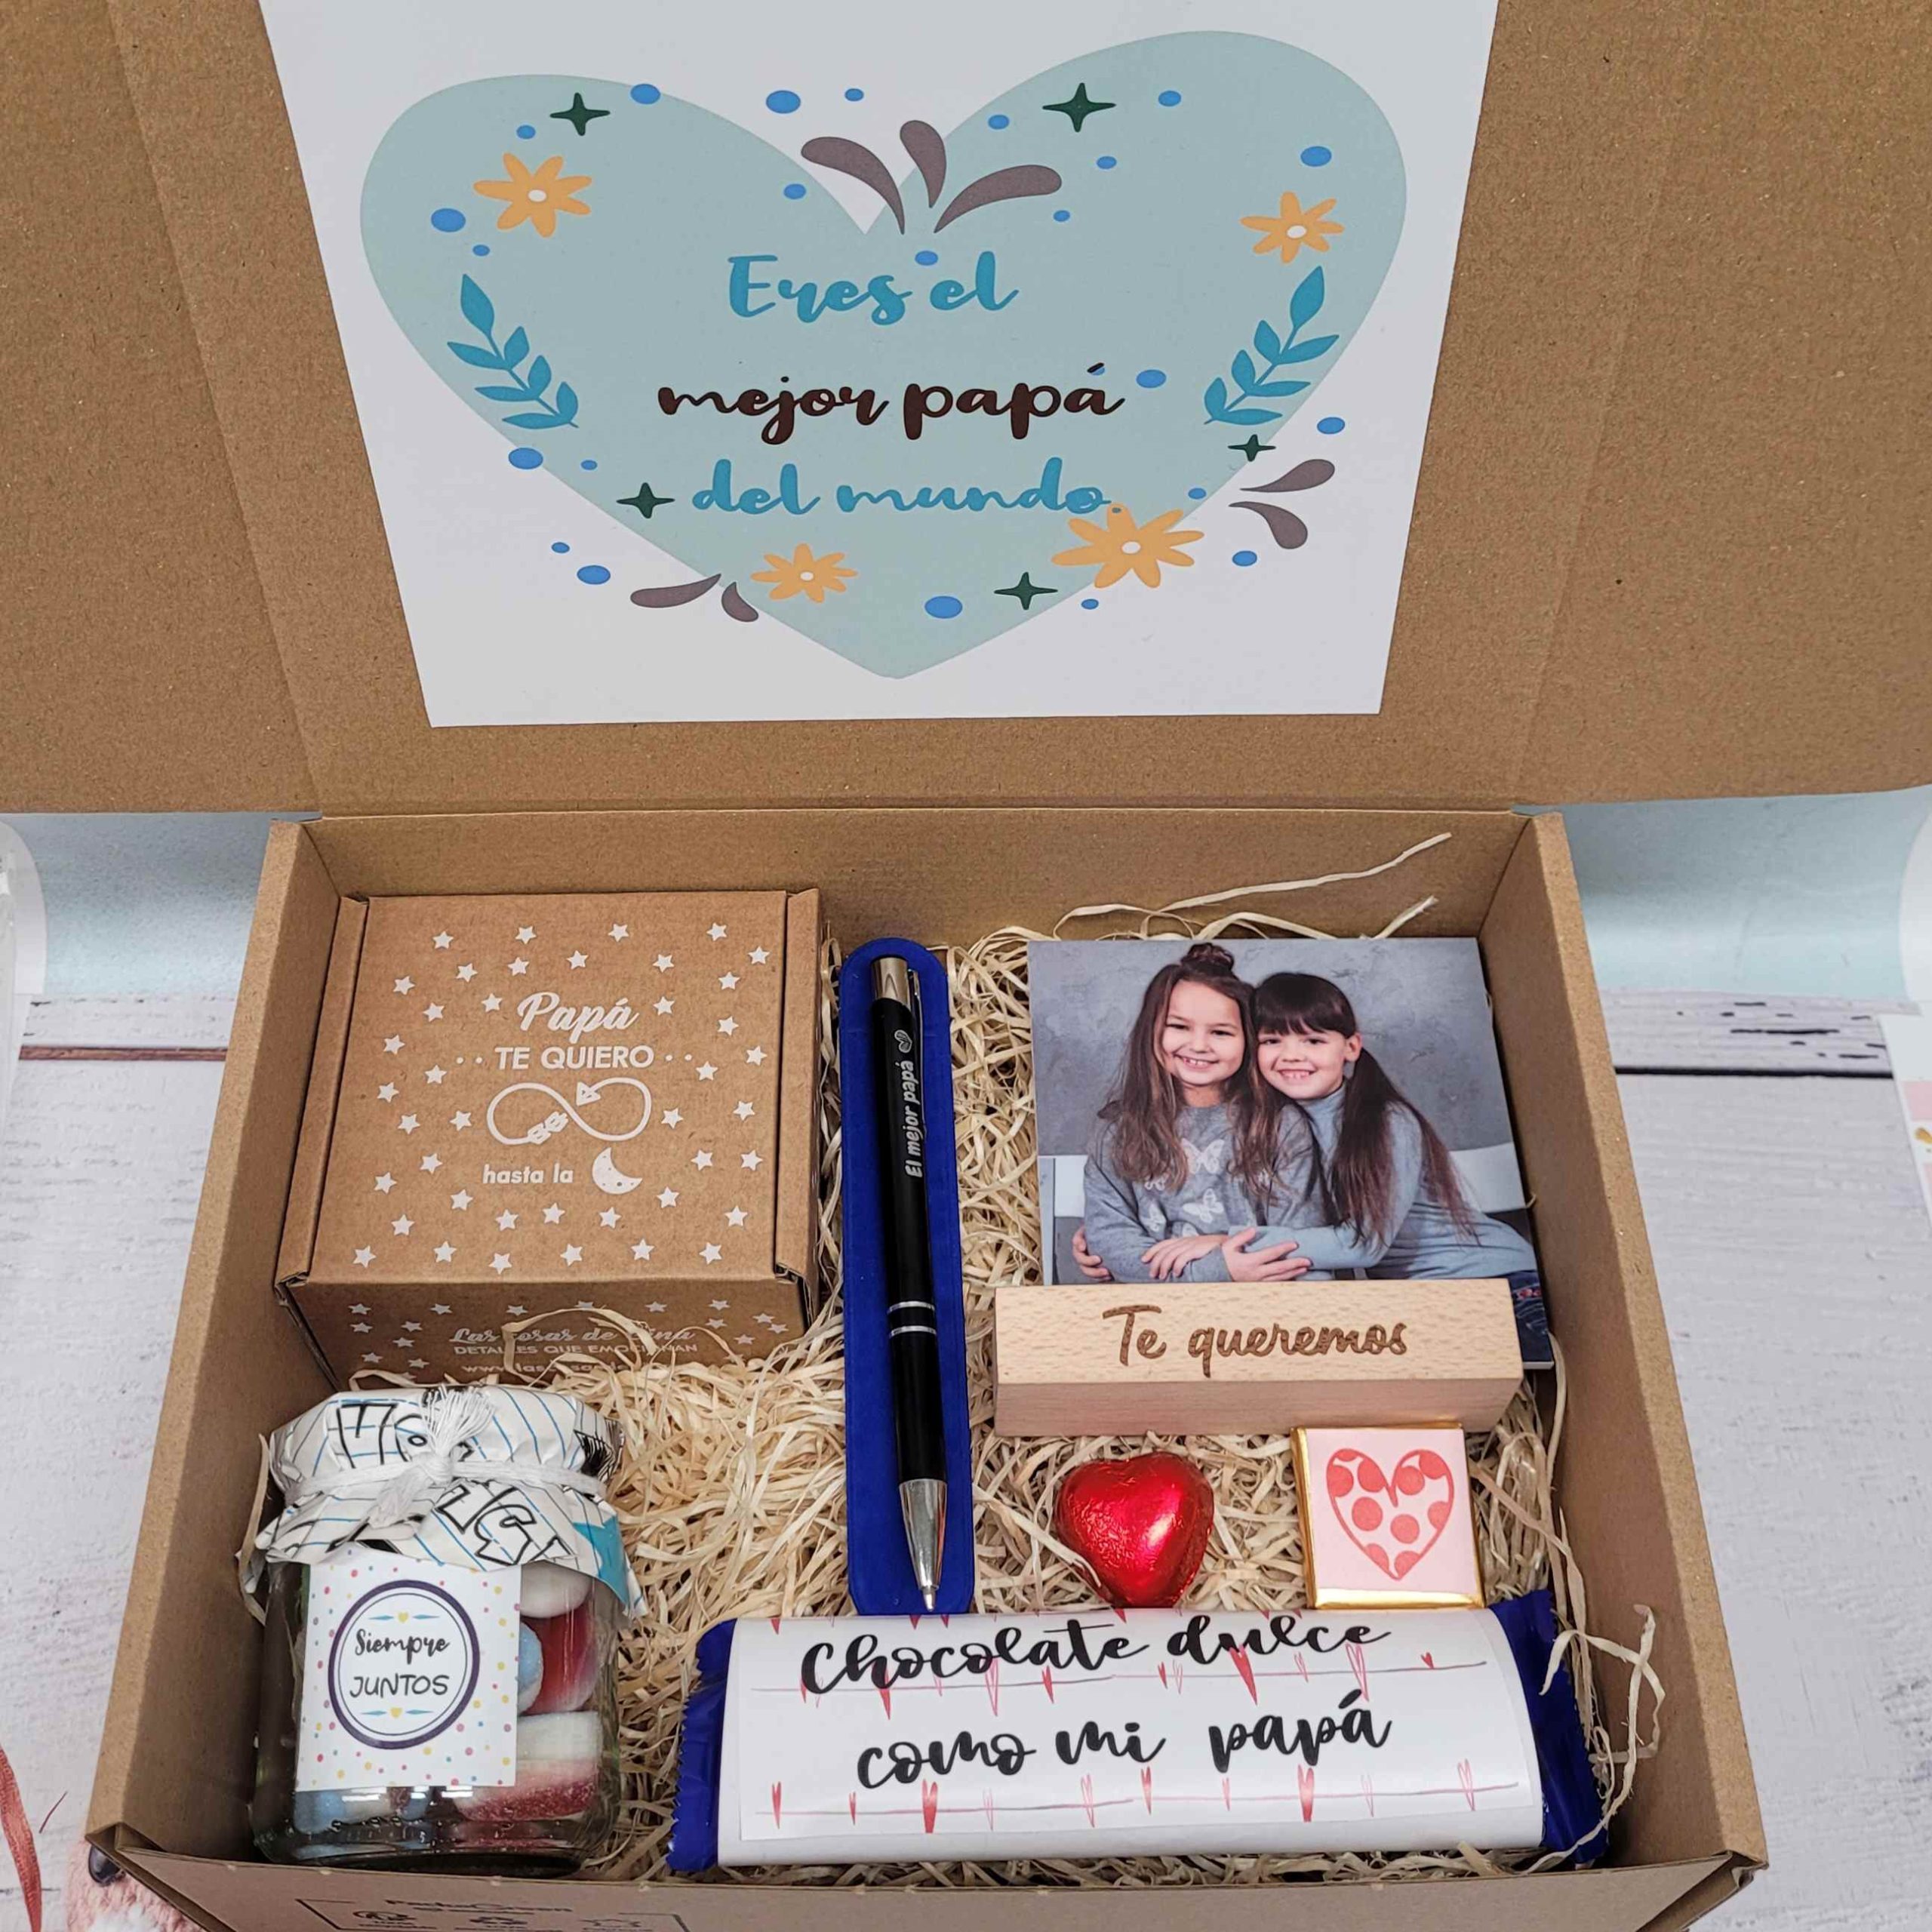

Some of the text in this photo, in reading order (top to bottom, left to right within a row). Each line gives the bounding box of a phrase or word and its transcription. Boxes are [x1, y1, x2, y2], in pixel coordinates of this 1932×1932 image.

[728, 251, 1019, 325] Eres el
[657, 362, 1125, 445] mejor papá
[692, 457, 1112, 515] del mundo
[517, 992, 639, 1044] Papá
[494, 1045, 654, 1070] TE QUIERO
[895, 1060, 924, 1177] El mejor papá
[482, 1163, 574, 1184] hasta la
[449, 1327, 500, 1344] Las
[512, 1329, 574, 1342] osas
[582, 1327, 618, 1341] de
[454, 1346, 539, 1355] DETALES
[543, 1345, 583, 1354] QUE
[1102, 1304, 1408, 1379] Te queremos
[355, 1628, 450, 1665] Siempre
[801, 1614, 1392, 1694] Chocolate dulce
[349, 1672, 450, 1698] JUNTOS
[857, 1688, 1392, 1789] como mi papá
